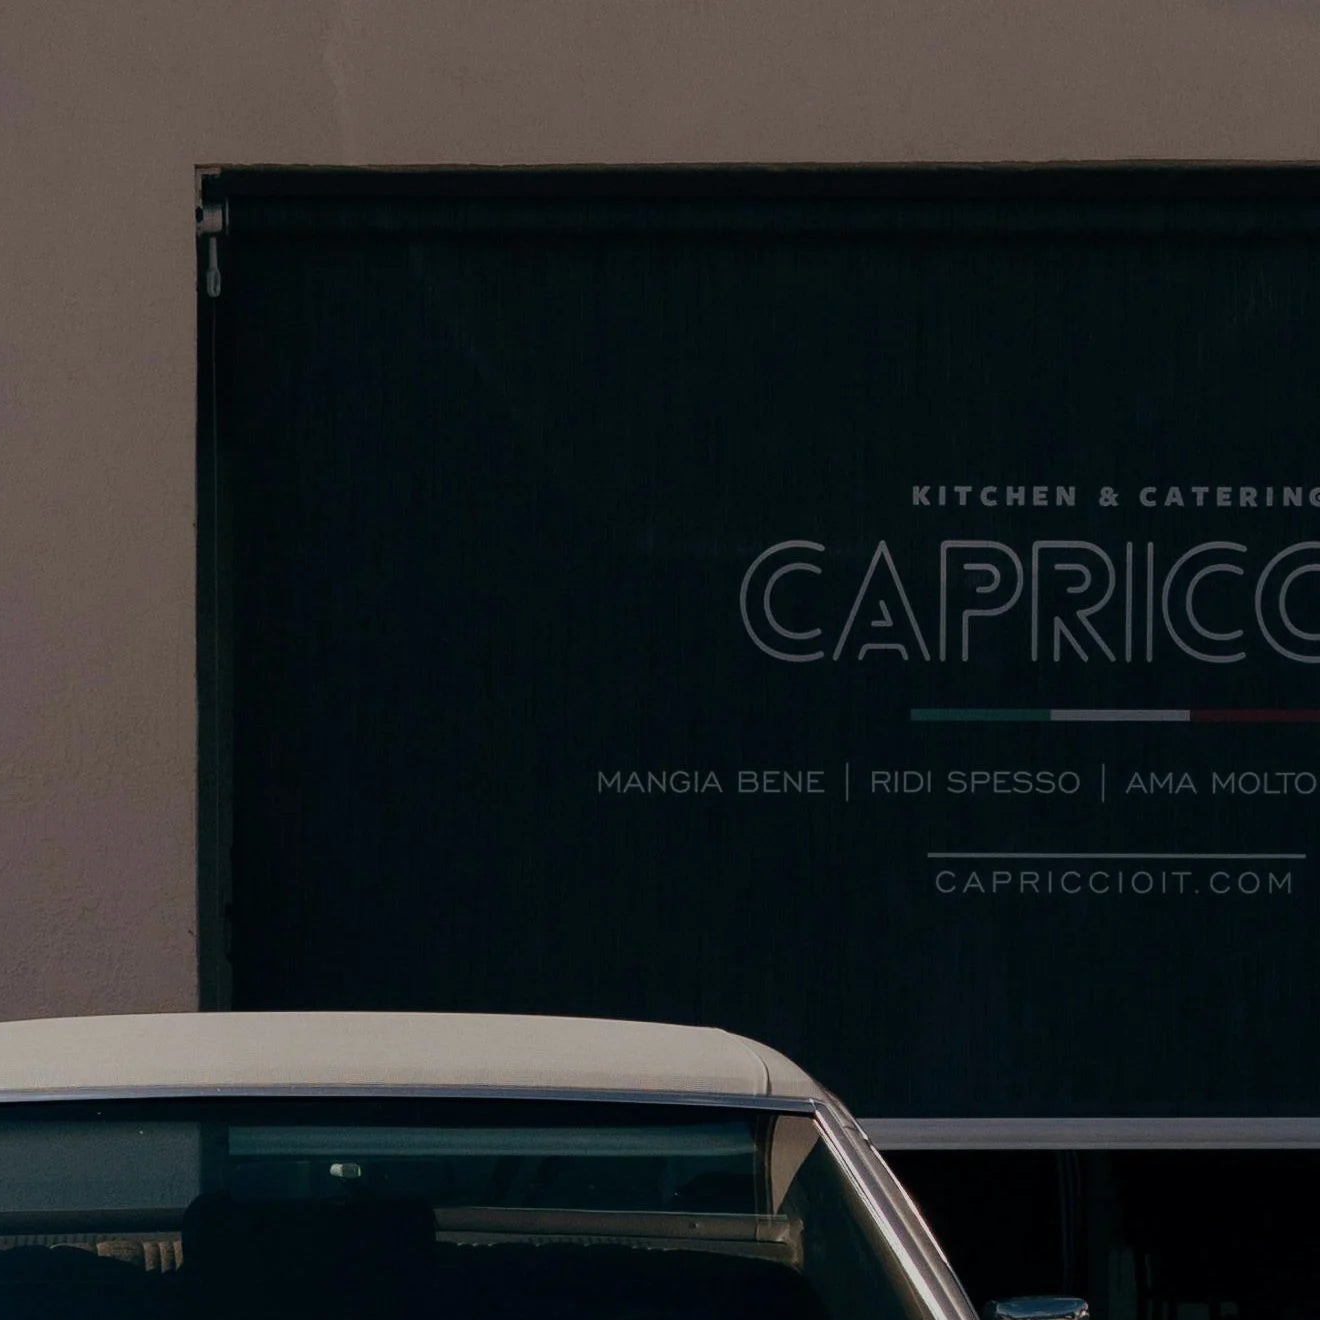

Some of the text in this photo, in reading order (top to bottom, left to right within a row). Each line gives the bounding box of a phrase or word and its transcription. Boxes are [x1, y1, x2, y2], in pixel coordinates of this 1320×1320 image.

[911, 484, 1077, 507] KITCHEN
[1098, 484, 1120, 508] &
[597, 770, 1317, 795] MANGIA BENE RIDI SPESSO AMA MOLTO
[935, 870, 1292, 895] CAPRICCIOIT.COM
